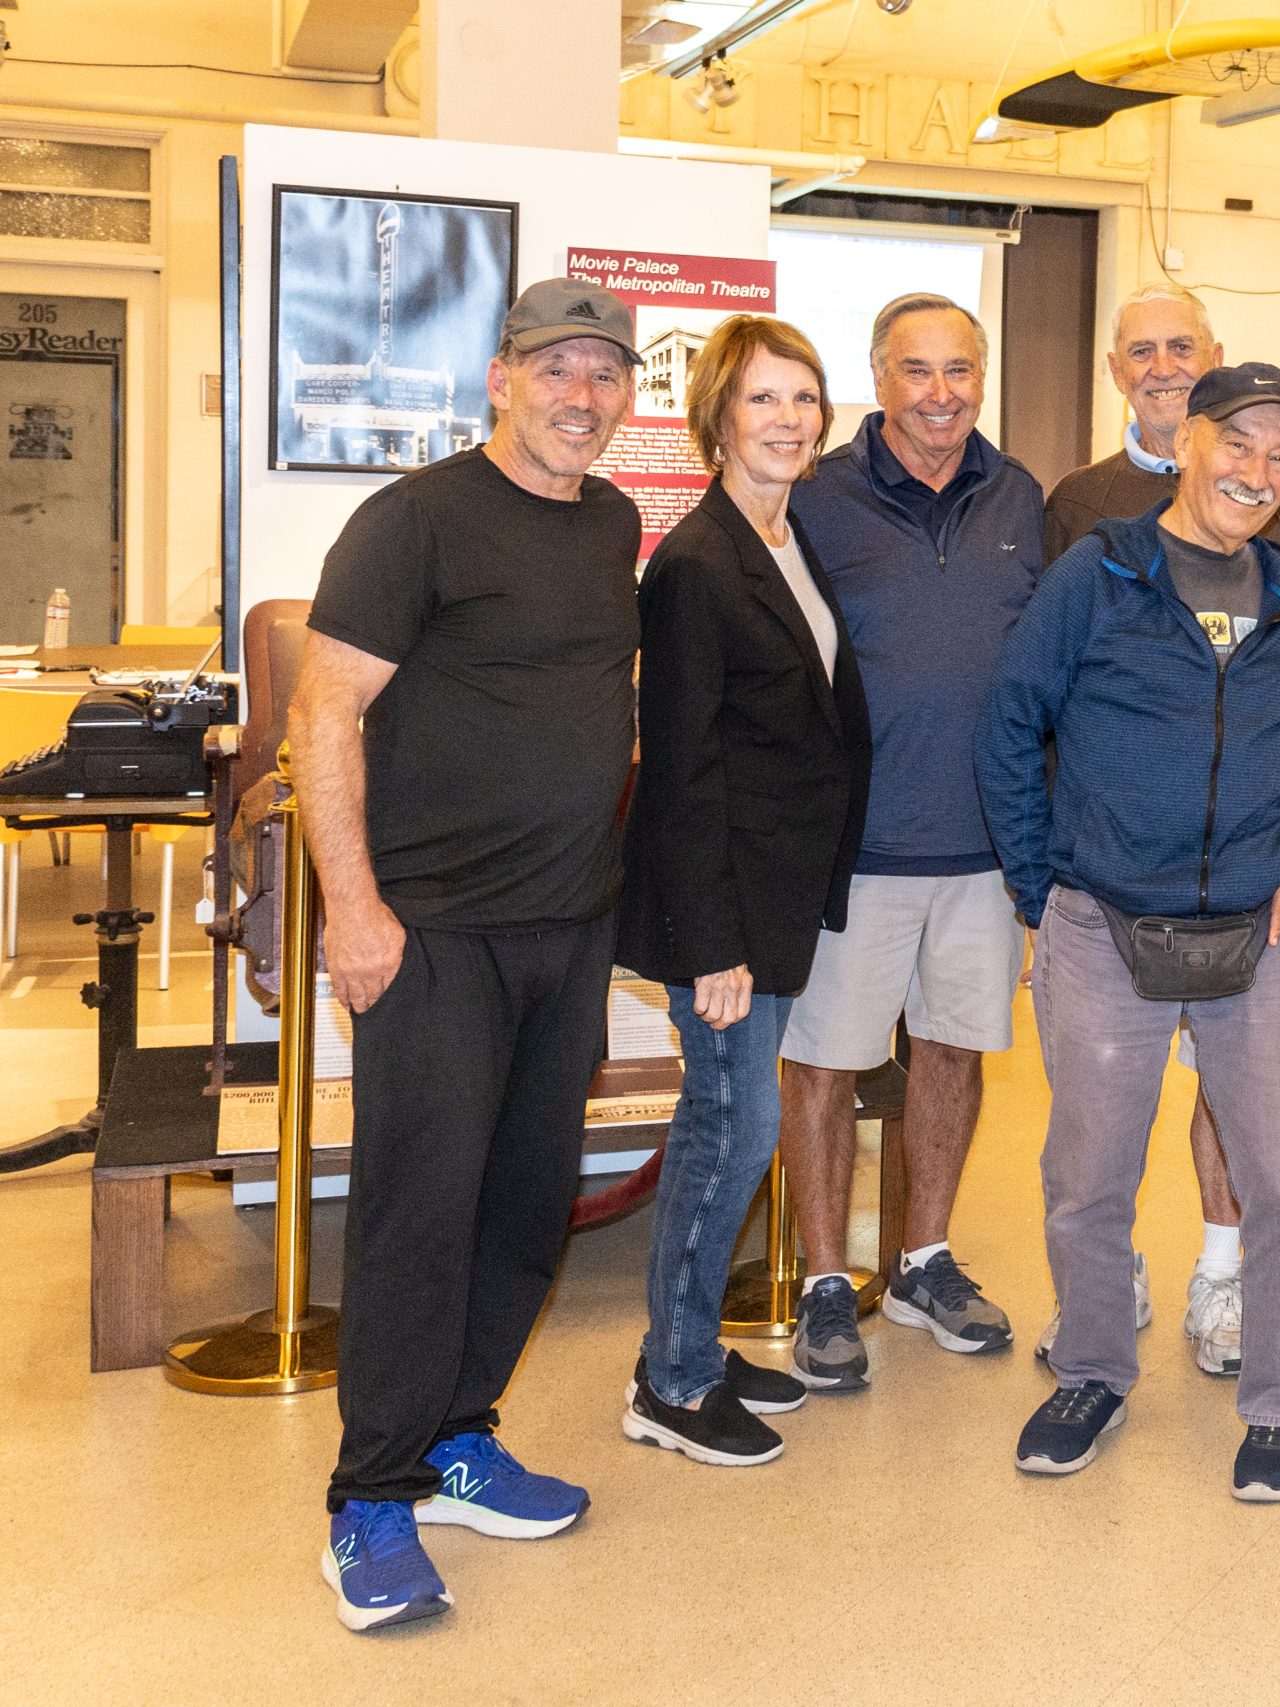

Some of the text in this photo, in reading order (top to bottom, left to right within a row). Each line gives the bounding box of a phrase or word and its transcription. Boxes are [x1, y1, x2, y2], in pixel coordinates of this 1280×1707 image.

[569, 253, 679, 276] Movie Palace
[380, 232, 392, 355] THEATRE
[605, 274, 706, 295] Metropolitan
[710, 280, 770, 299] Theatre
[18, 302, 58, 324] 205
[222, 1090, 275, 1100] $200,000
